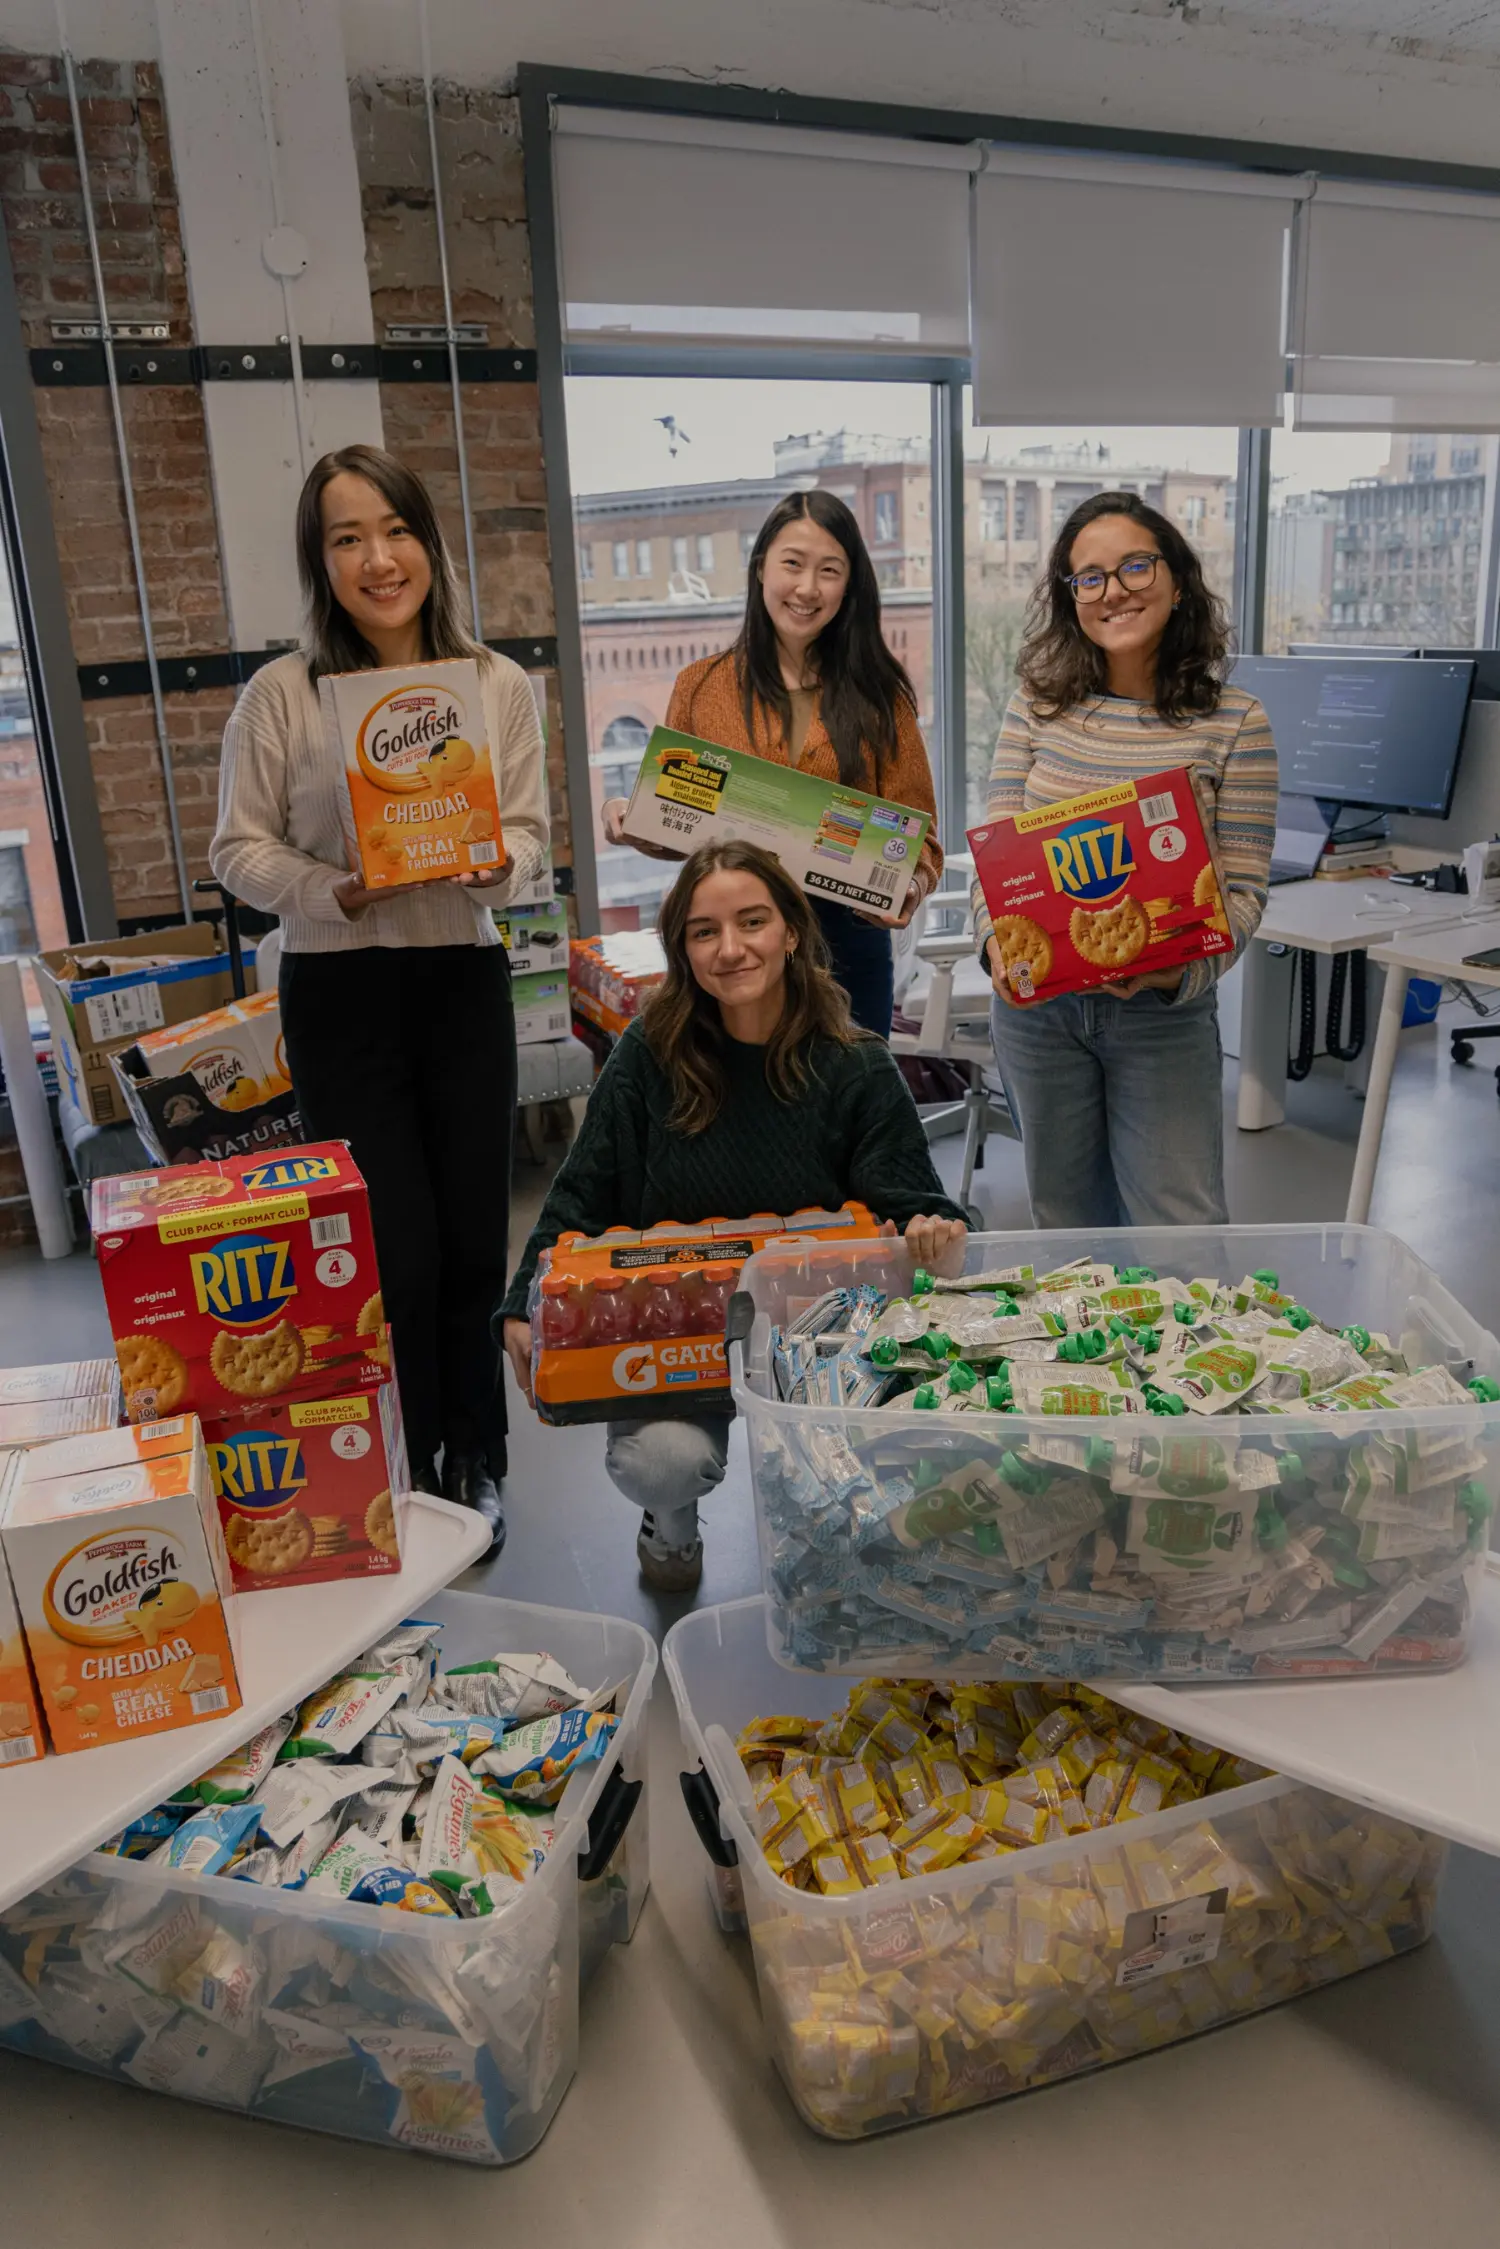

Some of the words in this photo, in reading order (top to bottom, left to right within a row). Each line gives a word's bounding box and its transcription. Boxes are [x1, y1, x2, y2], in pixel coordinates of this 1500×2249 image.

[372, 705, 459, 762] Goldfish
[667, 765, 693, 780] Roasted
[692, 773, 720, 789] Seaweed
[681, 761, 710, 777] Seasoned
[670, 779, 690, 793] Algues
[384, 792, 470, 824] CHEDDAR
[1020, 815, 1043, 829] CLUB
[1043, 809, 1067, 823] PACK
[1073, 797, 1110, 815] FORMAT
[1110, 789, 1134, 803] CLUB
[405, 838, 455, 858] VRAI
[888, 840, 906, 855] 36
[1161, 836, 1173, 849] 4
[408, 853, 459, 871] FROMAGE
[1042, 822, 1137, 893] RITZ
[1002, 872, 1036, 888] original
[809, 874, 821, 885] 36
[821, 878, 830, 888] X
[830, 881, 836, 890] 5
[837, 885, 845, 894] g
[844, 886, 865, 899] NET
[865, 892, 882, 905] 180
[882, 899, 890, 909] g
[1004, 890, 1046, 907] originaux
[1017, 978, 1033, 989] 100
[201, 1112, 303, 1161] NATURE
[241, 1157, 341, 1191] RITZ
[166, 1225, 195, 1239] CLUB
[195, 1221, 225, 1234] PACK
[232, 1212, 275, 1227] FORMAT
[277, 1207, 305, 1219] CLUB
[189, 1241, 298, 1314] RITZ
[329, 1260, 341, 1274] 4
[134, 1288, 176, 1304] original
[133, 1309, 186, 1326] originaux
[612, 1344, 657, 1391] G
[138, 1407, 157, 1418] 100
[299, 1413, 337, 1425] FORMAT
[338, 1411, 363, 1422] CLUB
[304, 1406, 329, 1417] CLUB
[330, 1405, 355, 1416] PACK
[344, 1435, 356, 1447] 4
[205, 1438, 308, 1498] RITZ
[64, 1546, 177, 1618] Goldfish
[92, 1591, 138, 1618] BAKED
[81, 1637, 195, 1681] CHEDDAR
[111, 1688, 132, 1700] BAKED
[114, 1690, 170, 1715] REAL
[116, 1705, 174, 1728] CHEESE
